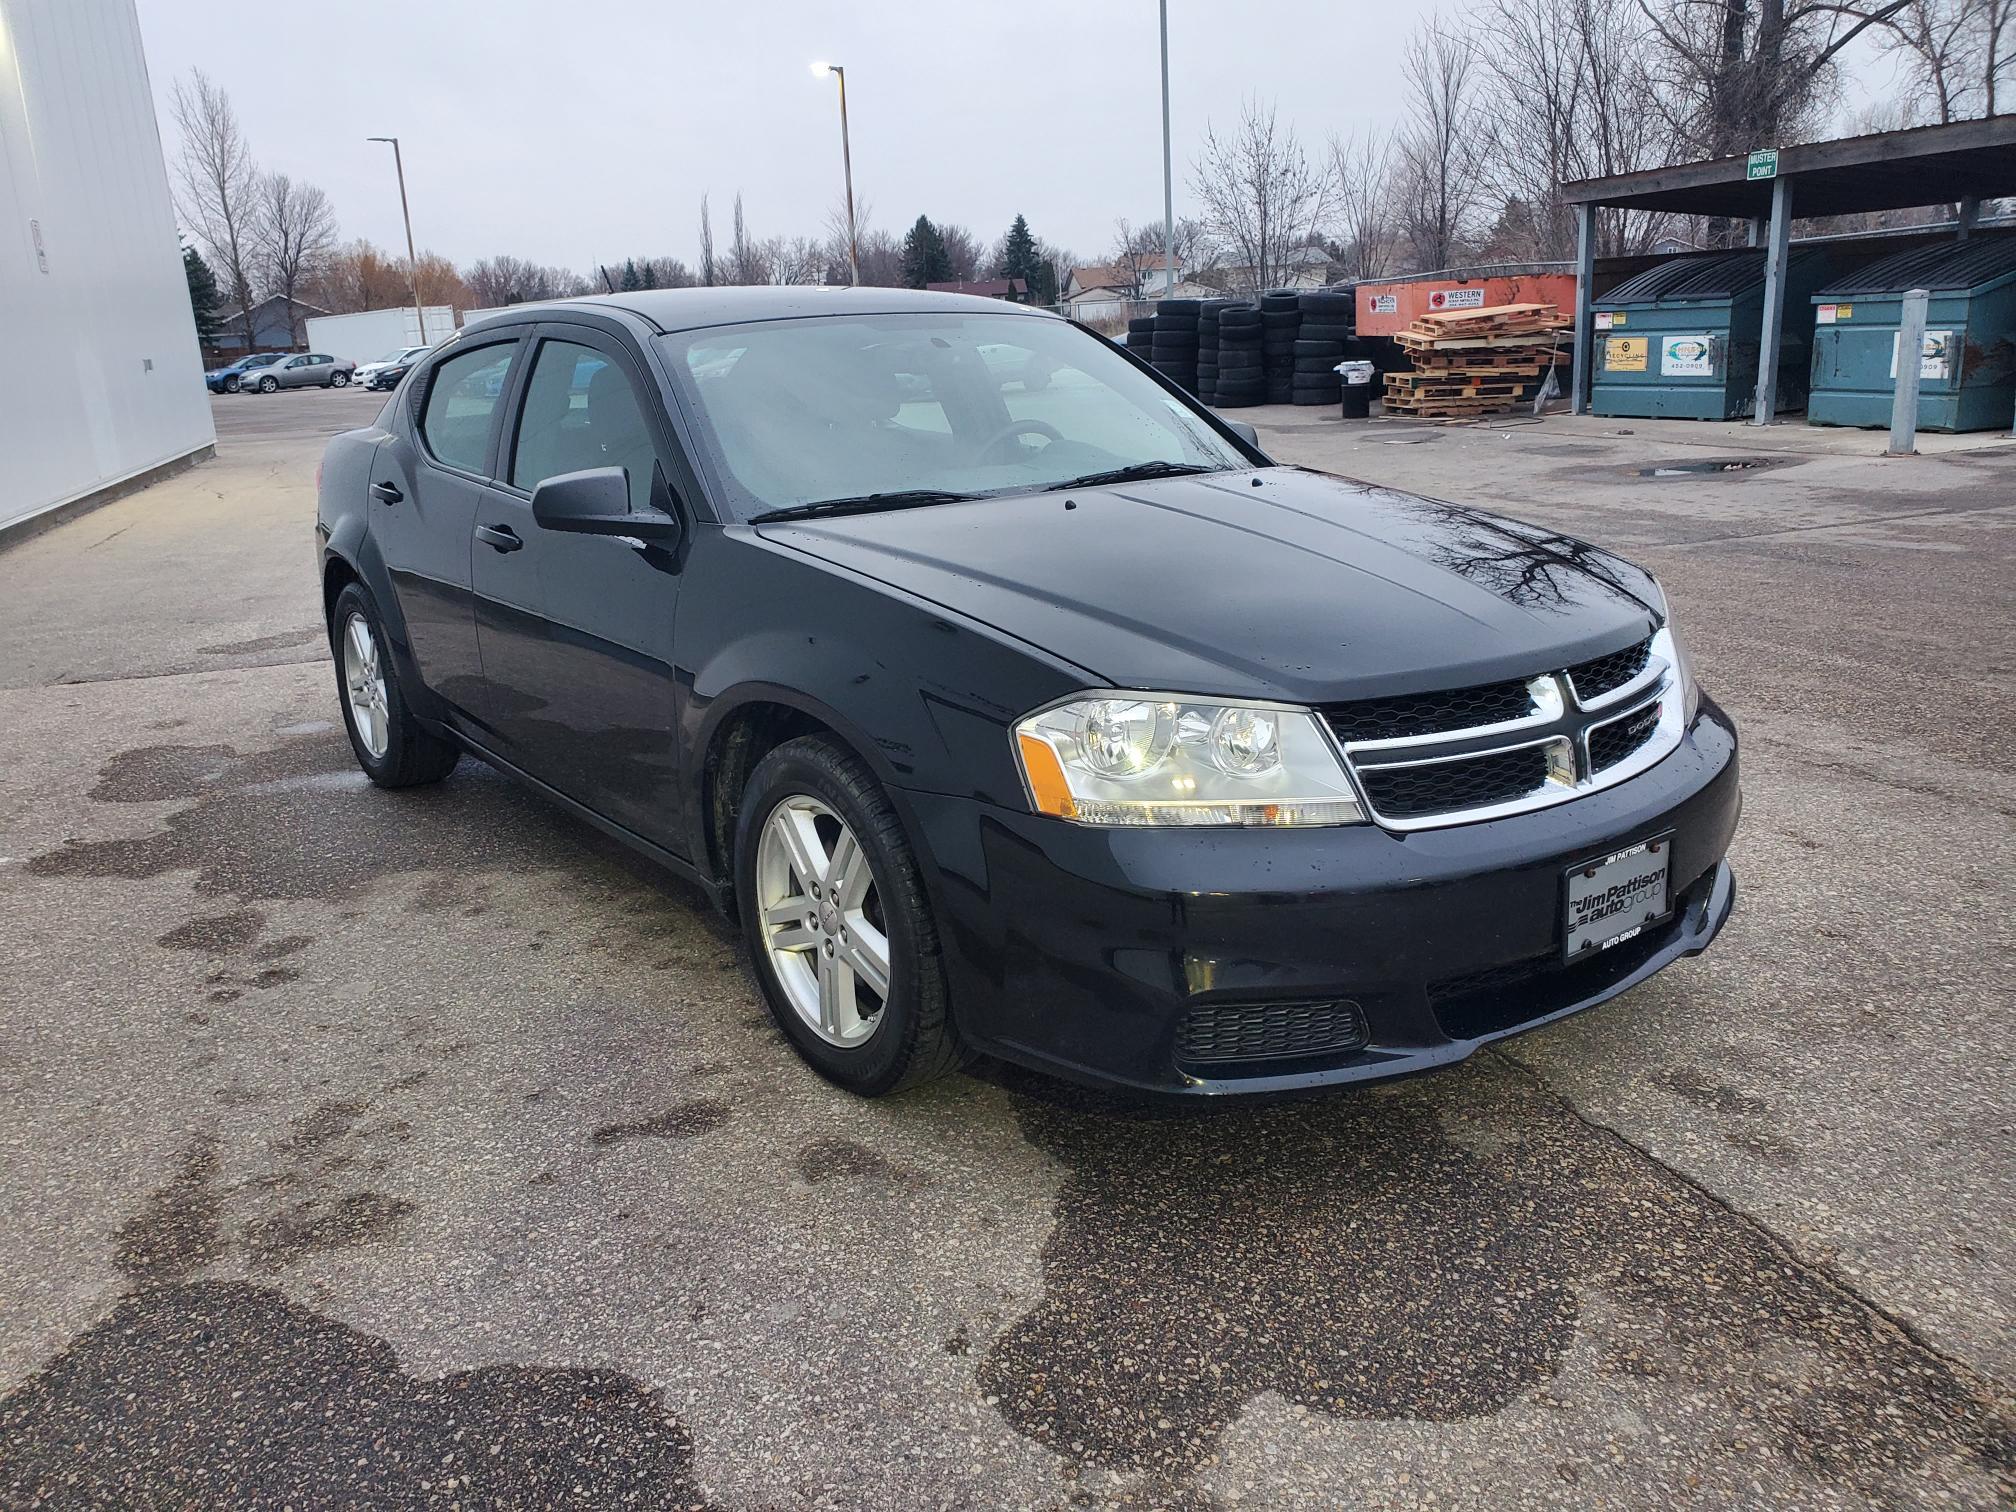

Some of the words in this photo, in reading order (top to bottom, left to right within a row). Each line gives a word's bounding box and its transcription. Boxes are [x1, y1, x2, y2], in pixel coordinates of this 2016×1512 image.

[1750, 152, 1776, 164] MUSTER
[1752, 165, 1772, 177] POINT
[1448, 290, 1482, 299] WESTERN
[1605, 855, 1617, 866] JIM
[1617, 843, 1647, 861] PATTISON
[1602, 937, 1619, 951] AUTO
[1620, 926, 1641, 943] GROUP
